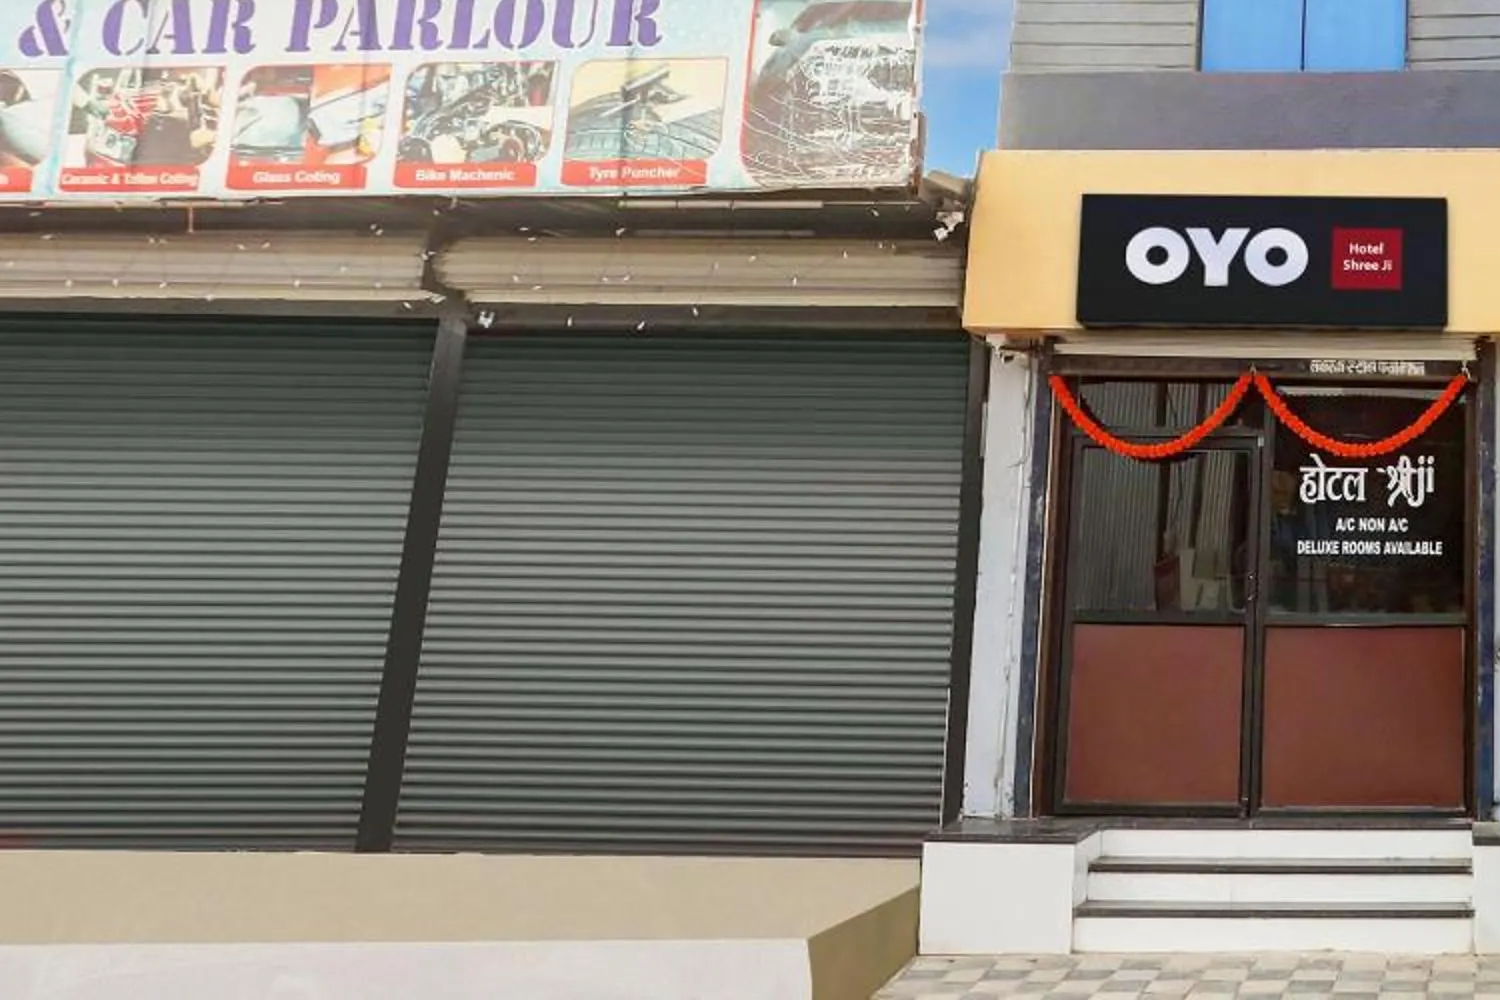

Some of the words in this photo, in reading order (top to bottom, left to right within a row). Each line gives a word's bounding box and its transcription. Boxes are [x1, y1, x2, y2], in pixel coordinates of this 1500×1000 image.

[252, 171, 291, 183] Glass
[415, 170, 446, 182] Bike
[621, 165, 681, 178] Puncher
[1348, 242, 1385, 255] Hotel
[1125, 226, 1309, 287] OYO
[1343, 259, 1379, 271] Shree
[1380, 260, 1393, 273] Ji
[1299, 453, 1369, 504] होटल
[1335, 517, 1355, 532] A/C
[1358, 517, 1385, 532] NON
[1388, 517, 1409, 532] A/C
[1297, 540, 1339, 555] DELUXE
[1341, 541, 1381, 555] ROOMS
[1384, 541, 1443, 555] AVAILABLE
